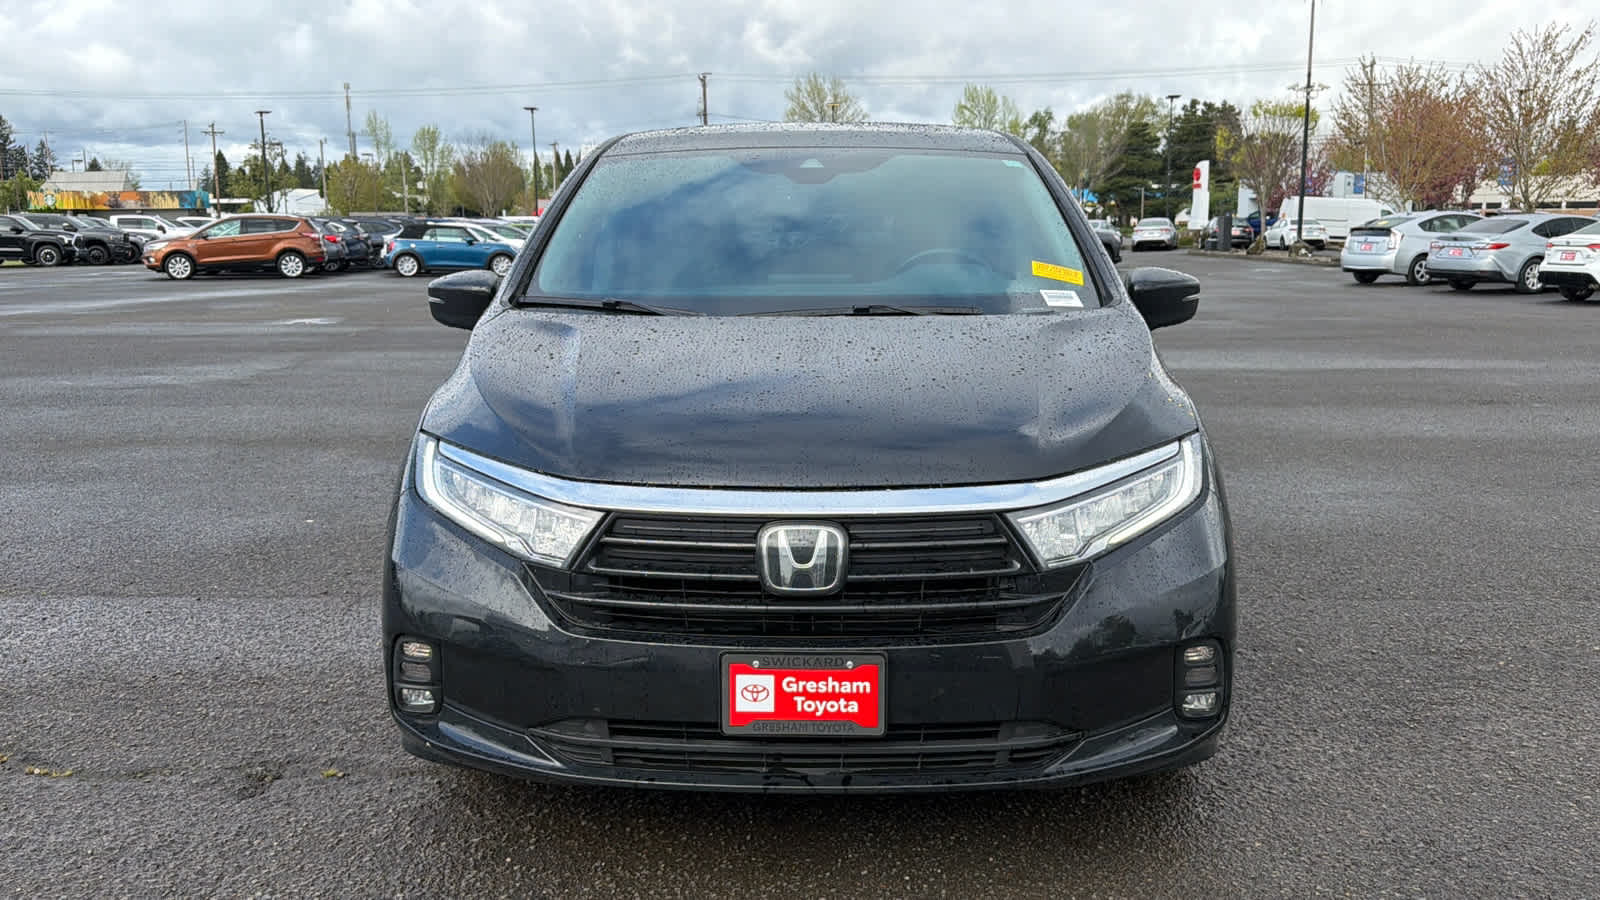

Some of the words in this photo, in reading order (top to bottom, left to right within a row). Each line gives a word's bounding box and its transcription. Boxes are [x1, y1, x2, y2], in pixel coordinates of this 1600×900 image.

[762, 656, 845, 668] SWICKARD
[781, 676, 871, 694] Gresham
[793, 696, 859, 716] Toyota
[751, 722, 809, 733] GRESHAM
[811, 722, 856, 733] TOYOTA
